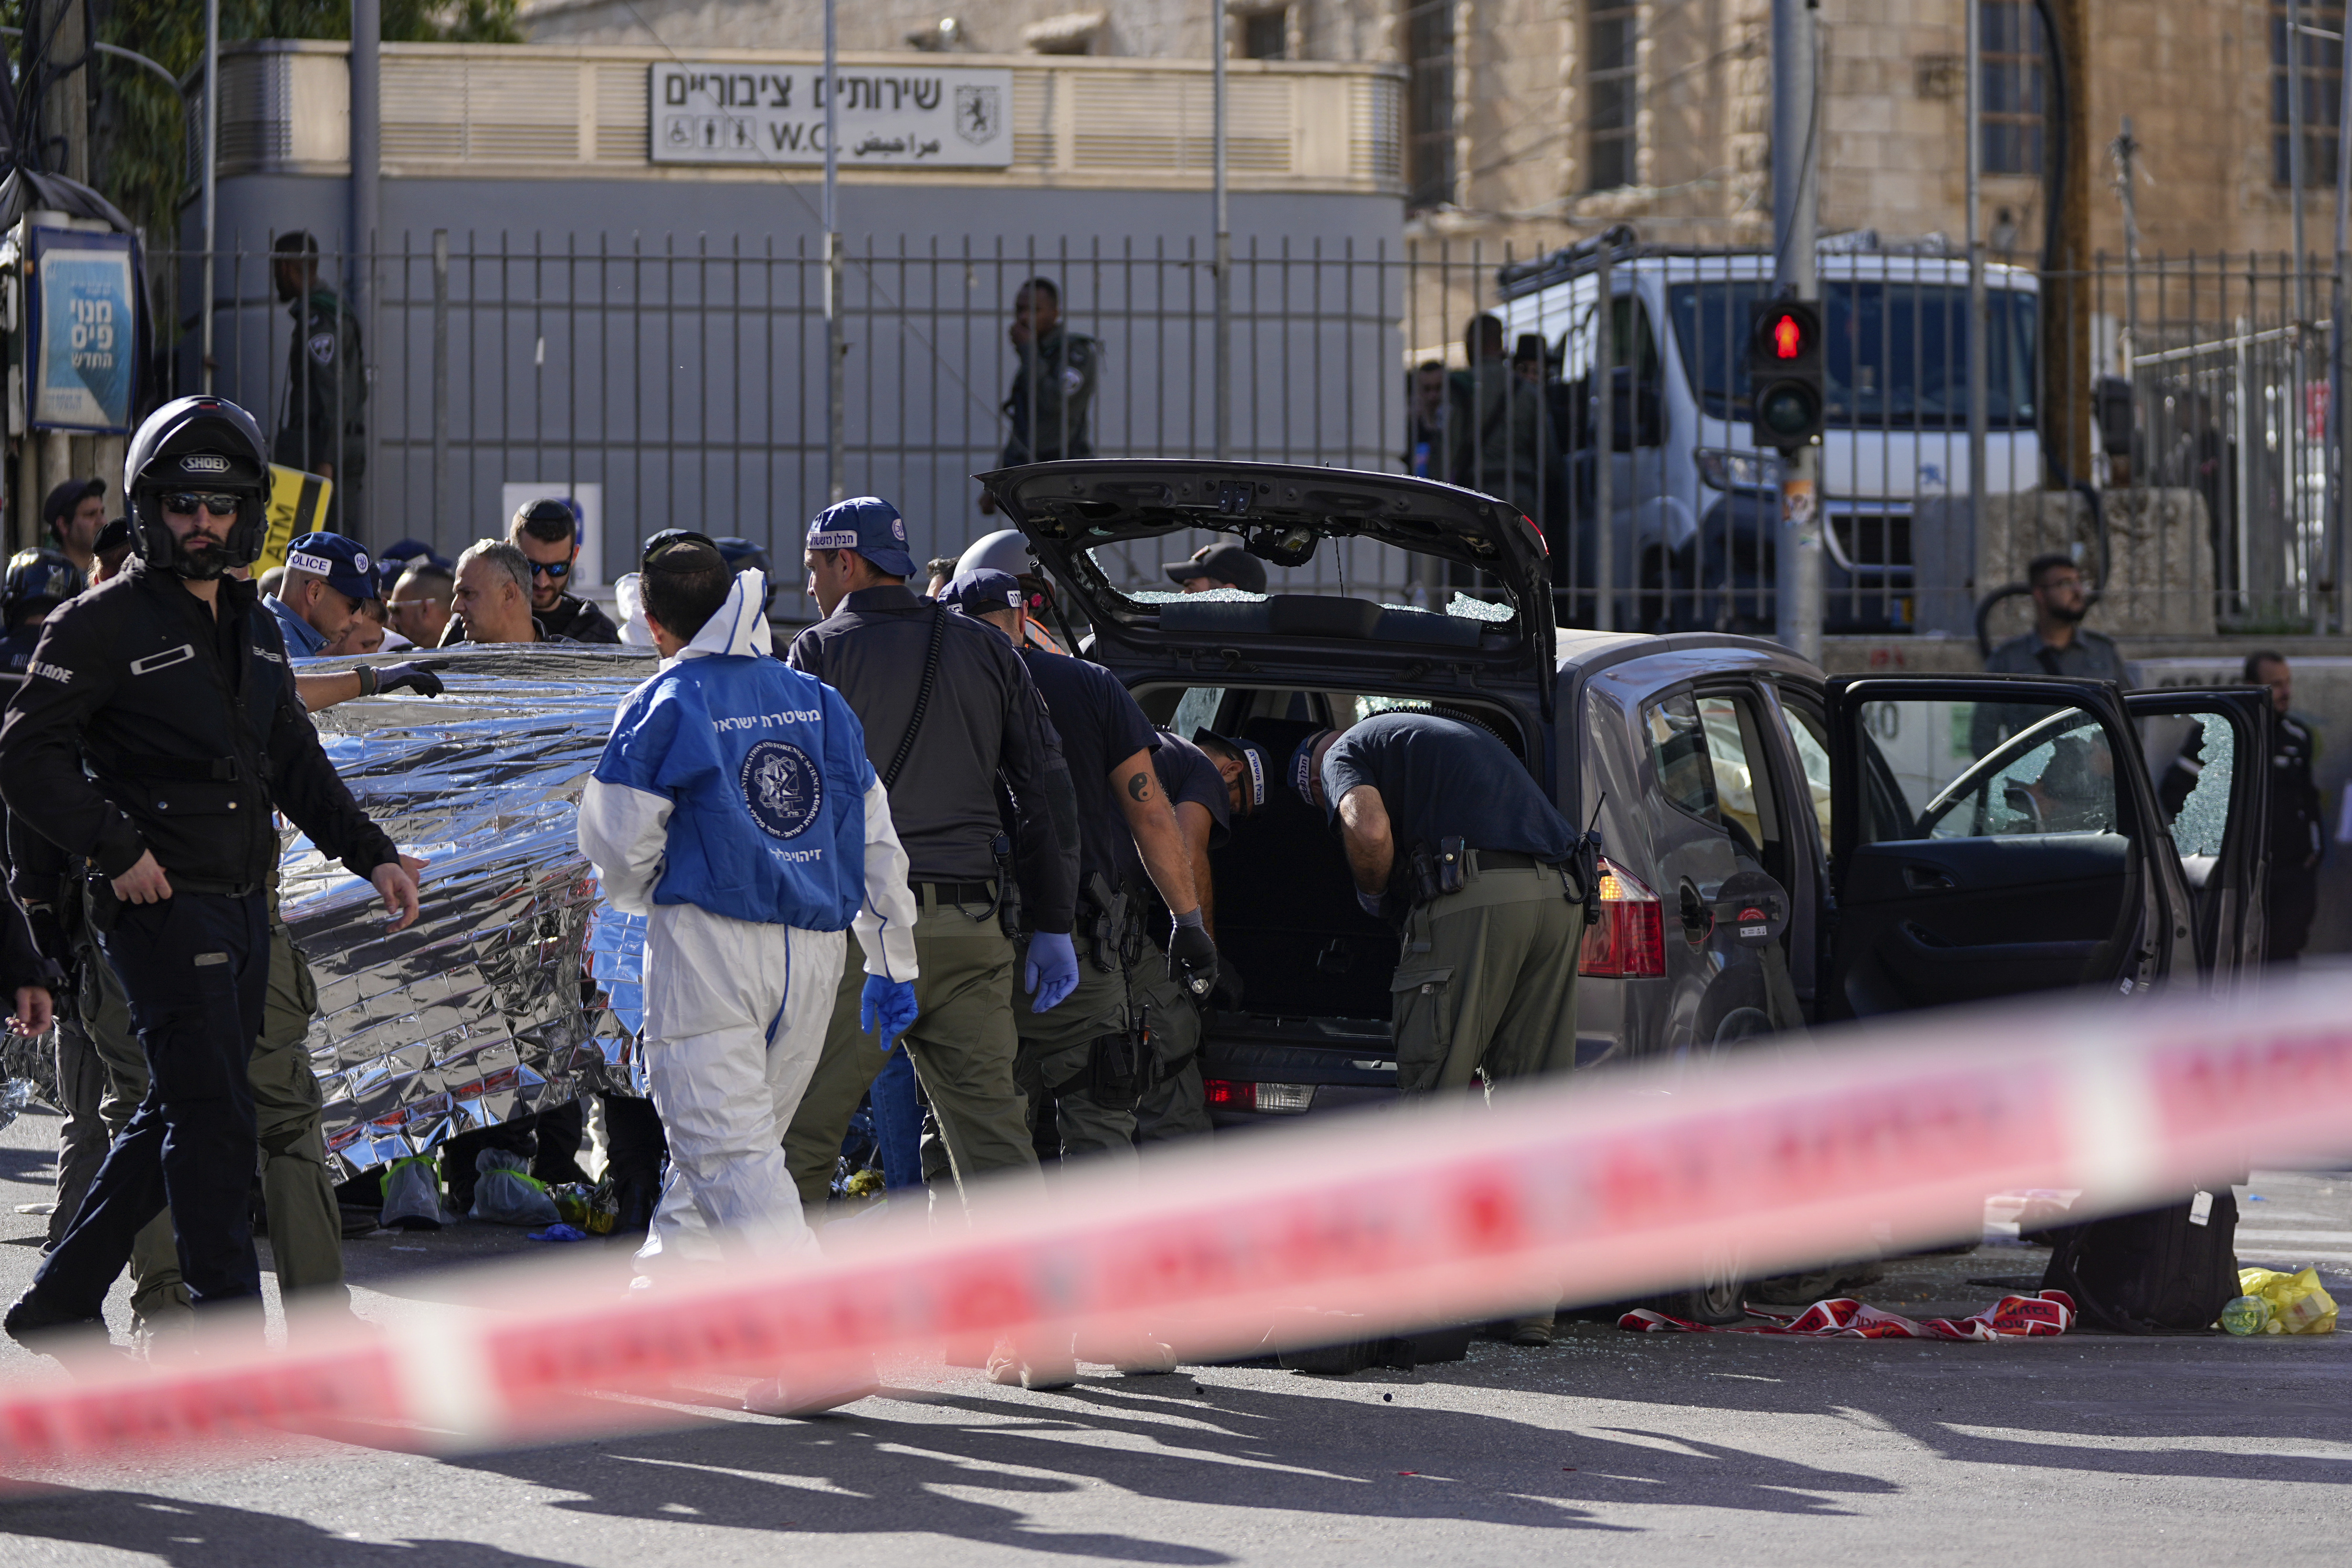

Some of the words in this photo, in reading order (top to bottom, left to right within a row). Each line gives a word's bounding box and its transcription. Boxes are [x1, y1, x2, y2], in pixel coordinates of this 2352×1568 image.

[666, 74, 792, 106] ציבוריים
[814, 78, 941, 110] שירותים
[854, 130, 940, 158] مراحيض
[70, 299, 112, 324] מנוי
[72, 324, 113, 349] פיס
[73, 353, 112, 369] החדש
[186, 457, 224, 469] SHOEI
[266, 503, 295, 561] ATM
[834, 533, 853, 547] חבלן
[760, 709, 821, 727] משטרת
[741, 742, 764, 801] IDENTIFICATION
[773, 742, 807, 761] FORENSIC
[804, 760, 820, 793] SCIENCE
[1248, 751, 1260, 781] משטרה
[1299, 758, 1308, 779] חבלן
[803, 799, 820, 826] משטרת
[784, 824, 804, 838] ישראל
[768, 848, 792, 861] פליל
